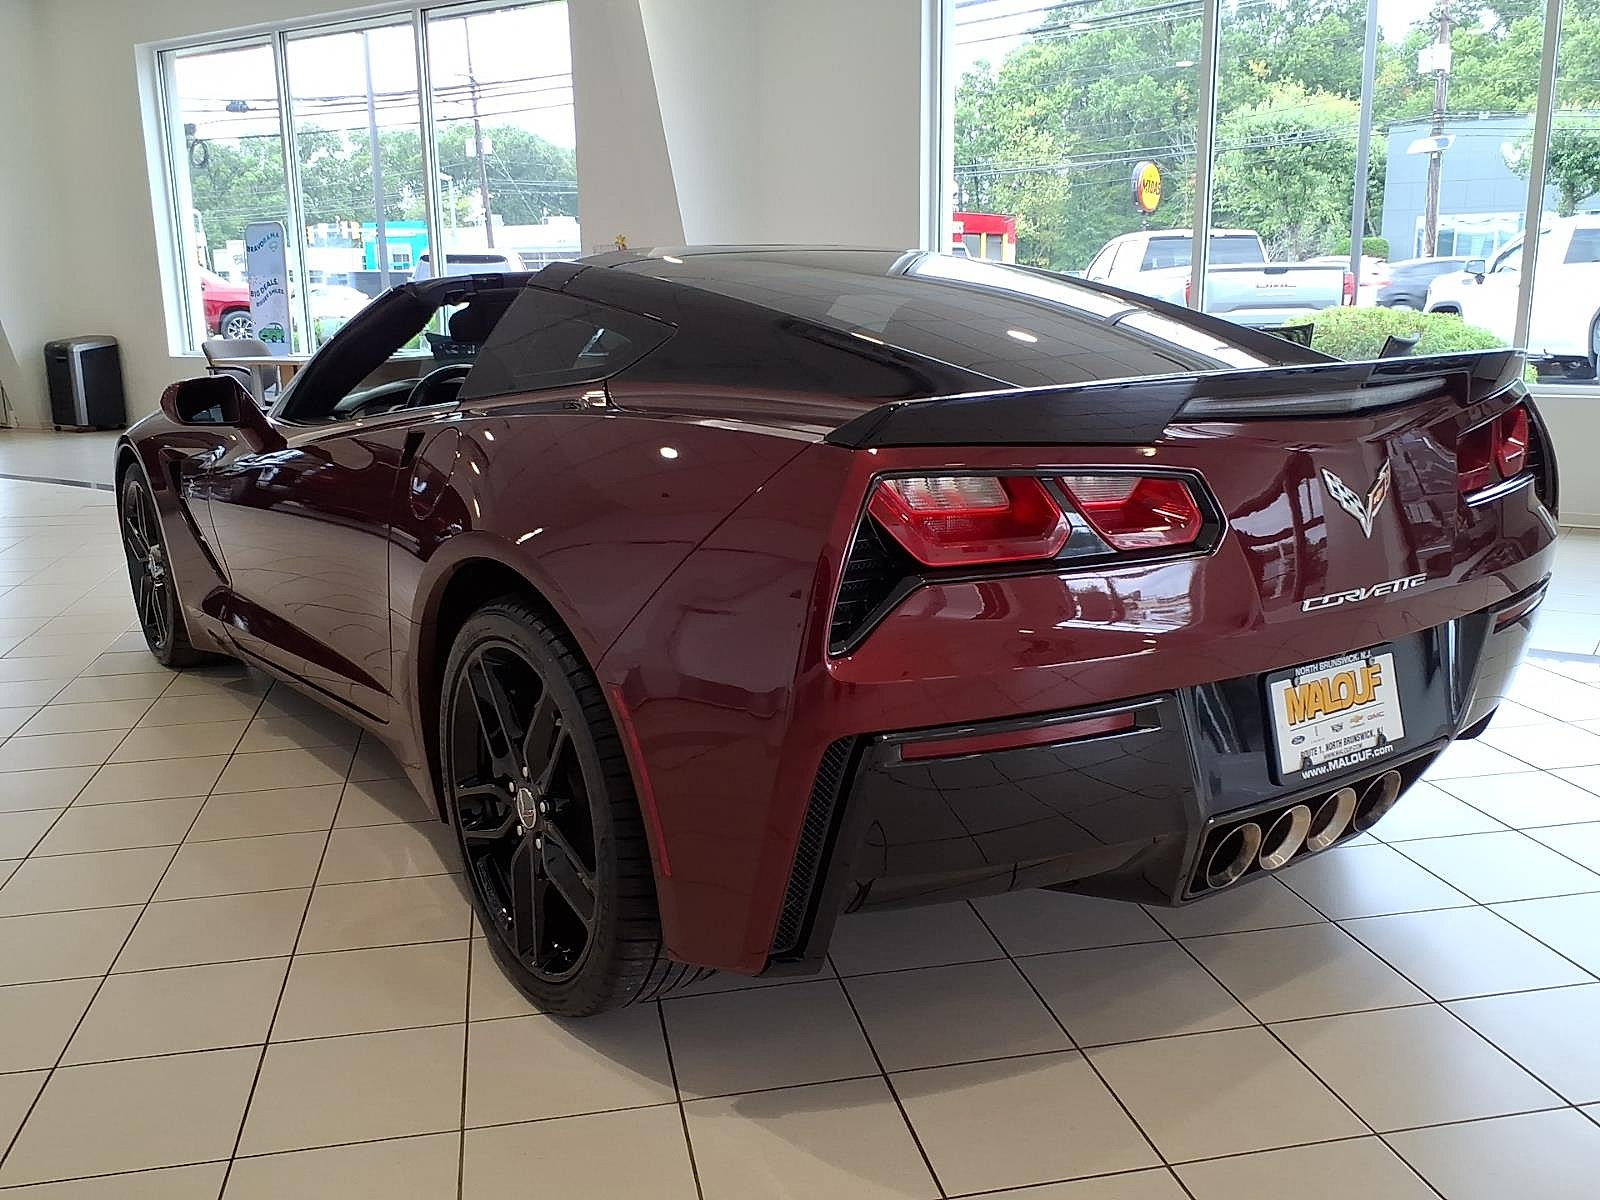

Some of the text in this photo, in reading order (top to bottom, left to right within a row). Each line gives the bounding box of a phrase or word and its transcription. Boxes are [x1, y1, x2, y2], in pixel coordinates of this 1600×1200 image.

[1143, 179, 1161, 195] MIDAS
[1302, 572, 1427, 612] CORVETTE
[1295, 663, 1319, 676] NORTH
[1284, 662, 1383, 726] MALOUF
[1325, 740, 1342, 752] NORTH
[1301, 744, 1393, 779] www.MALOUF.com
